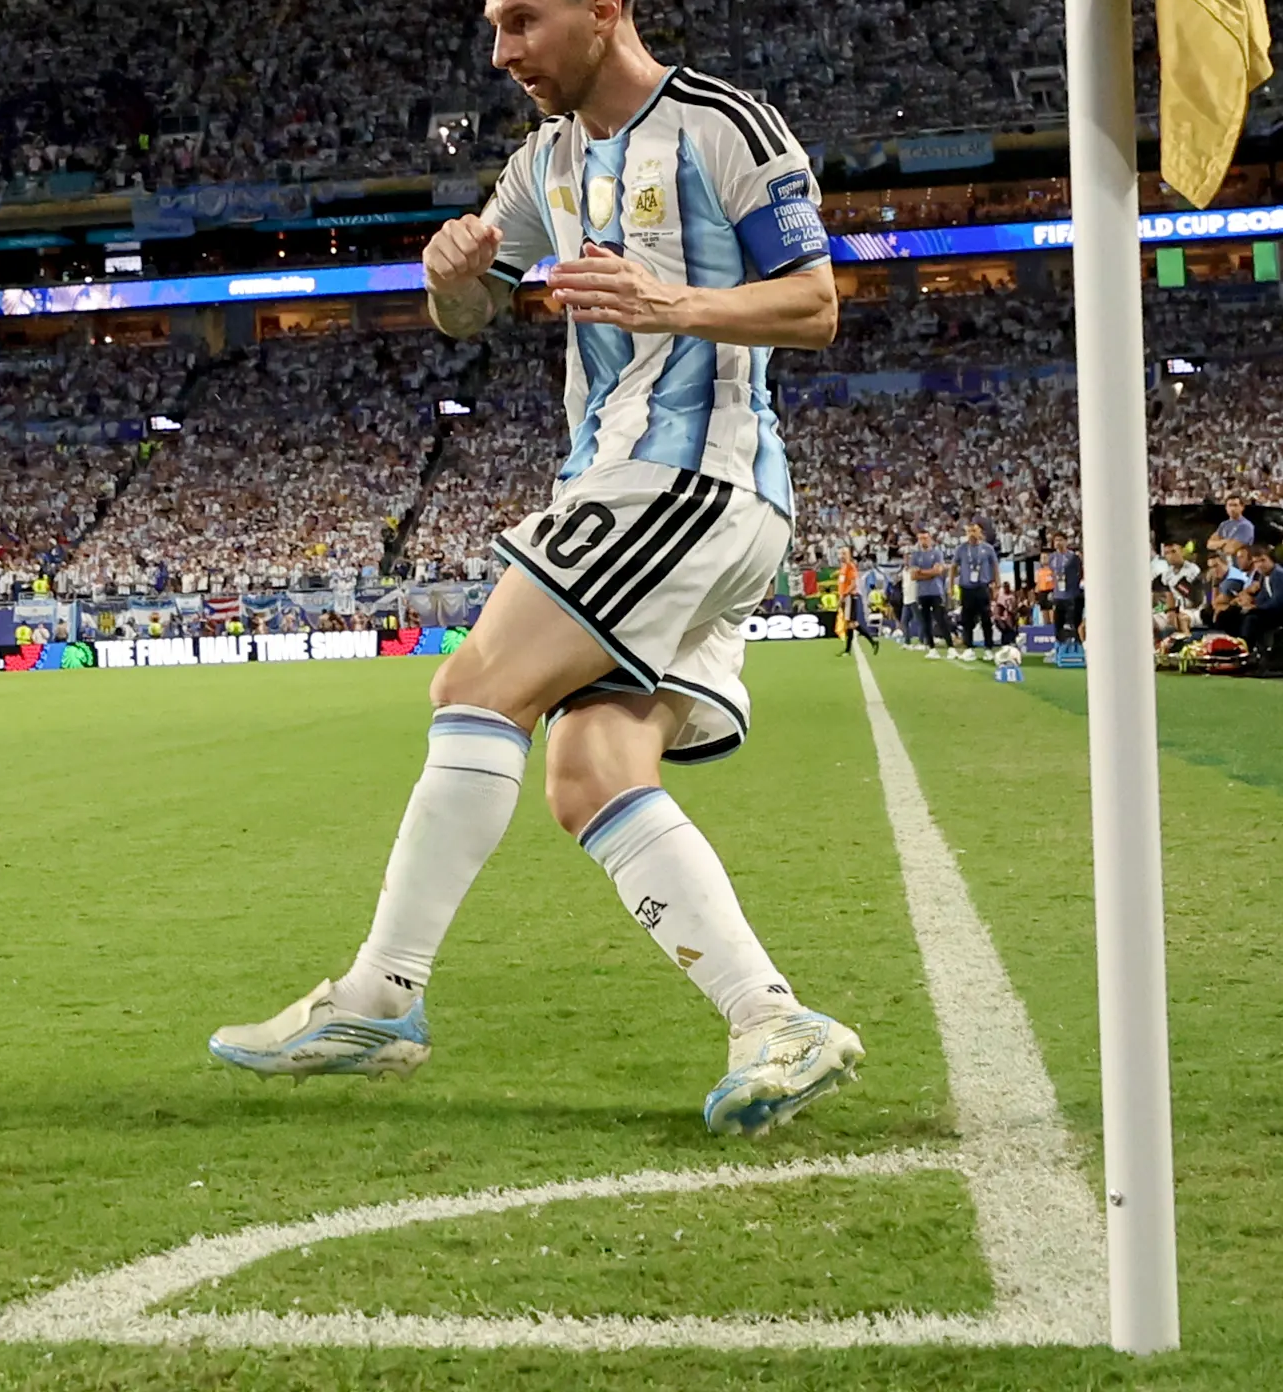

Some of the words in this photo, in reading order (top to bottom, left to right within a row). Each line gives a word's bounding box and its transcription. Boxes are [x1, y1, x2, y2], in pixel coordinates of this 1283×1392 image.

[636, 187, 658, 213] AFA
[773, 202, 814, 218] FOOTBA
[1137, 217, 1174, 239] RLD
[1176, 215, 1225, 236] CUP
[1227, 209, 1283, 232] 202
[739, 614, 820, 641] 026
[95, 640, 135, 668] THE
[136, 637, 199, 666] FINAL
[199, 635, 253, 664] HALF
[253, 633, 309, 662] TIME
[310, 630, 378, 659] SHOW
